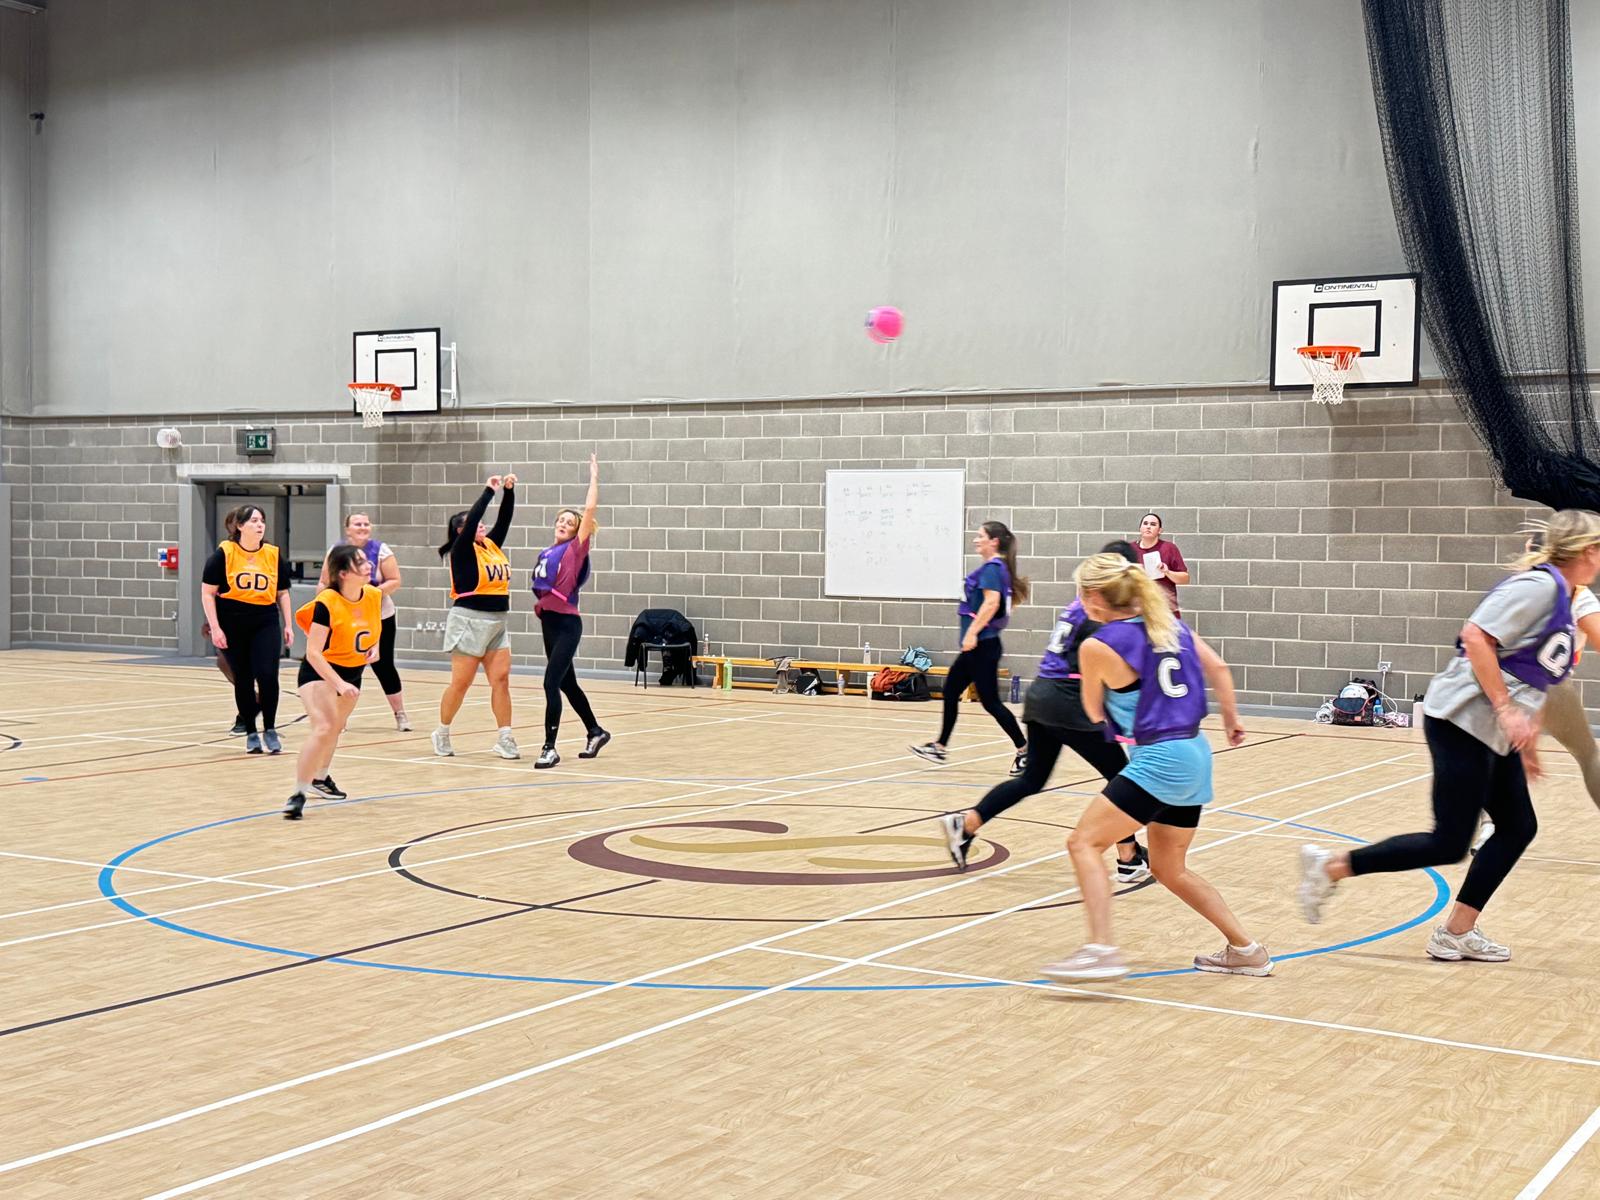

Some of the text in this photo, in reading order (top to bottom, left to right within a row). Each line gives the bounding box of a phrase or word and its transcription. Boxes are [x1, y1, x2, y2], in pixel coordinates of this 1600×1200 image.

[1314, 282, 1375, 293] CONTINENTAL
[236, 572, 269, 591] GD
[355, 630, 371, 653] C
[1537, 631, 1571, 678] Q
[1158, 656, 1189, 698] C
